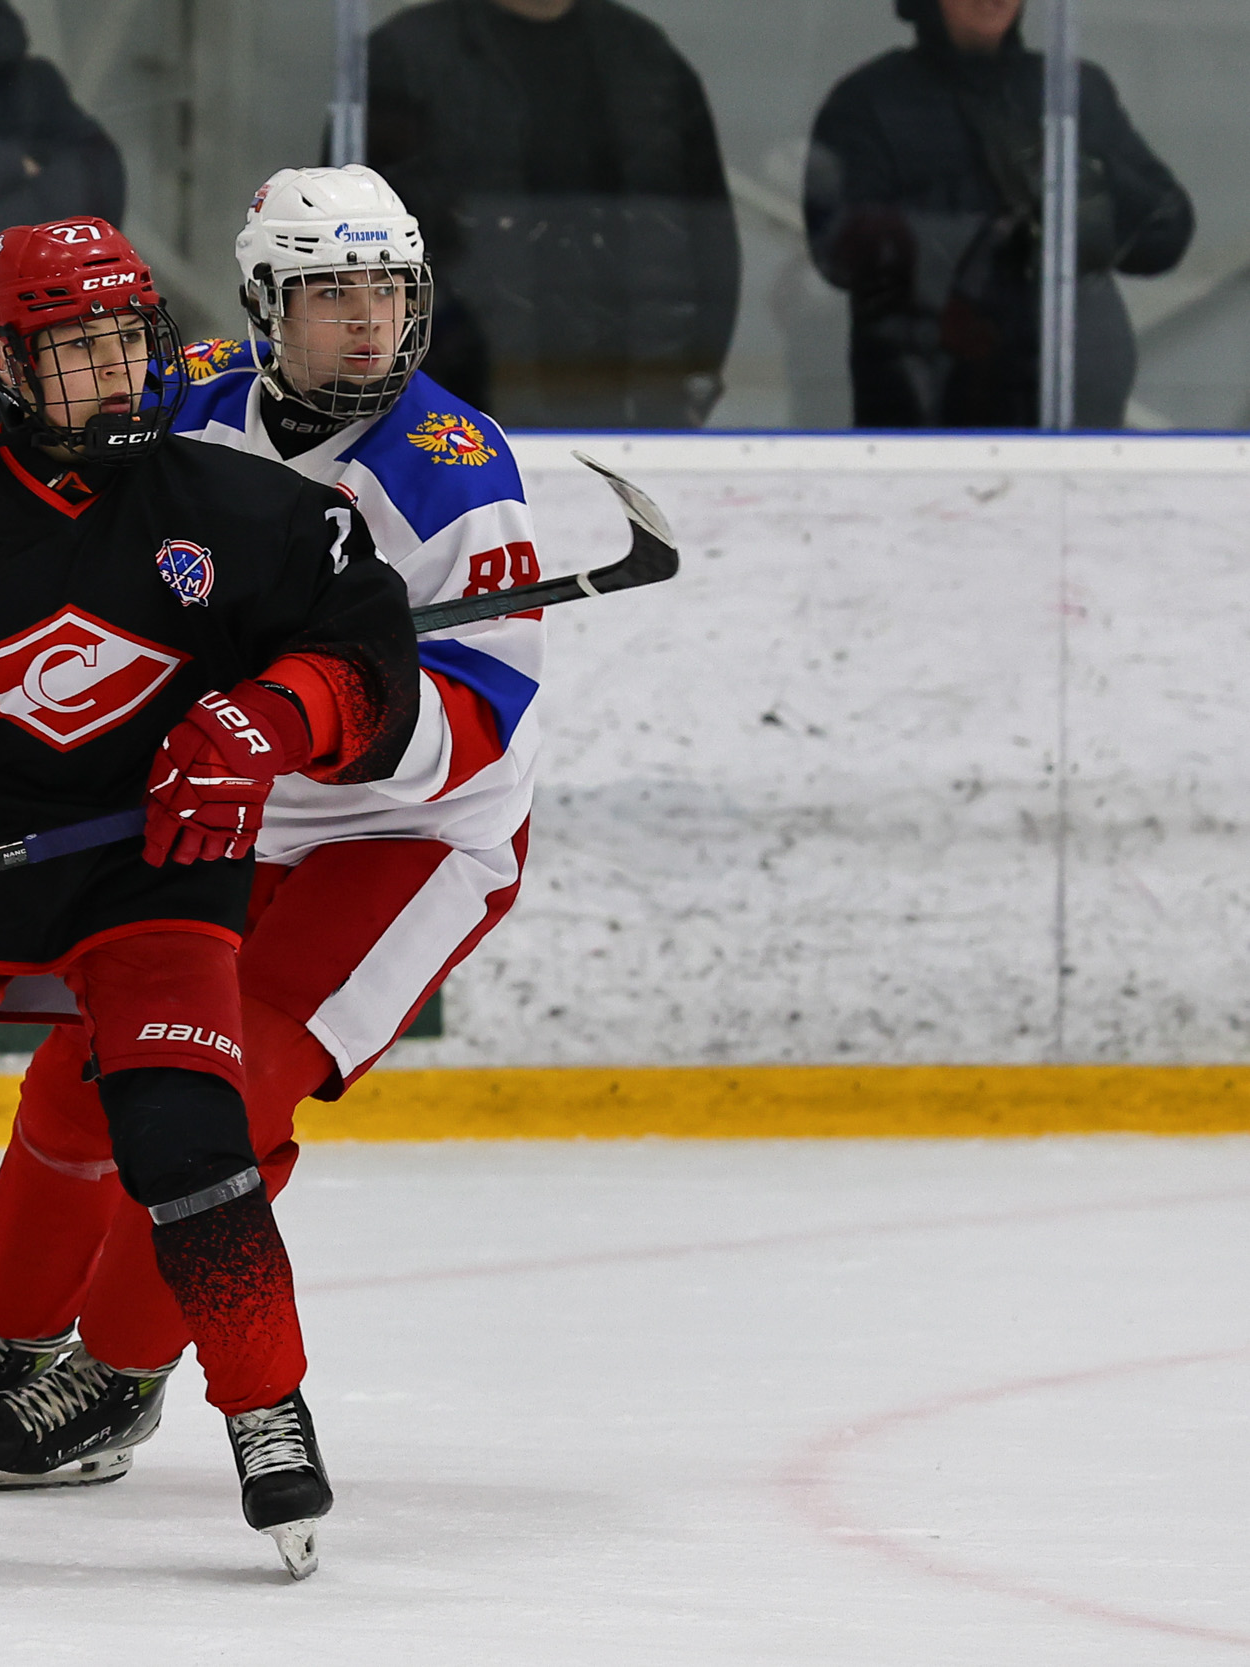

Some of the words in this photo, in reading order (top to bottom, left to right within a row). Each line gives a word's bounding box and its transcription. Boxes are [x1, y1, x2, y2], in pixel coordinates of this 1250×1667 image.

[52, 224, 102, 245] 27
[351, 230, 388, 242] ГАЗПРОМ
[81, 271, 136, 291] CCM
[136, 1023, 243, 1066] BAUER
